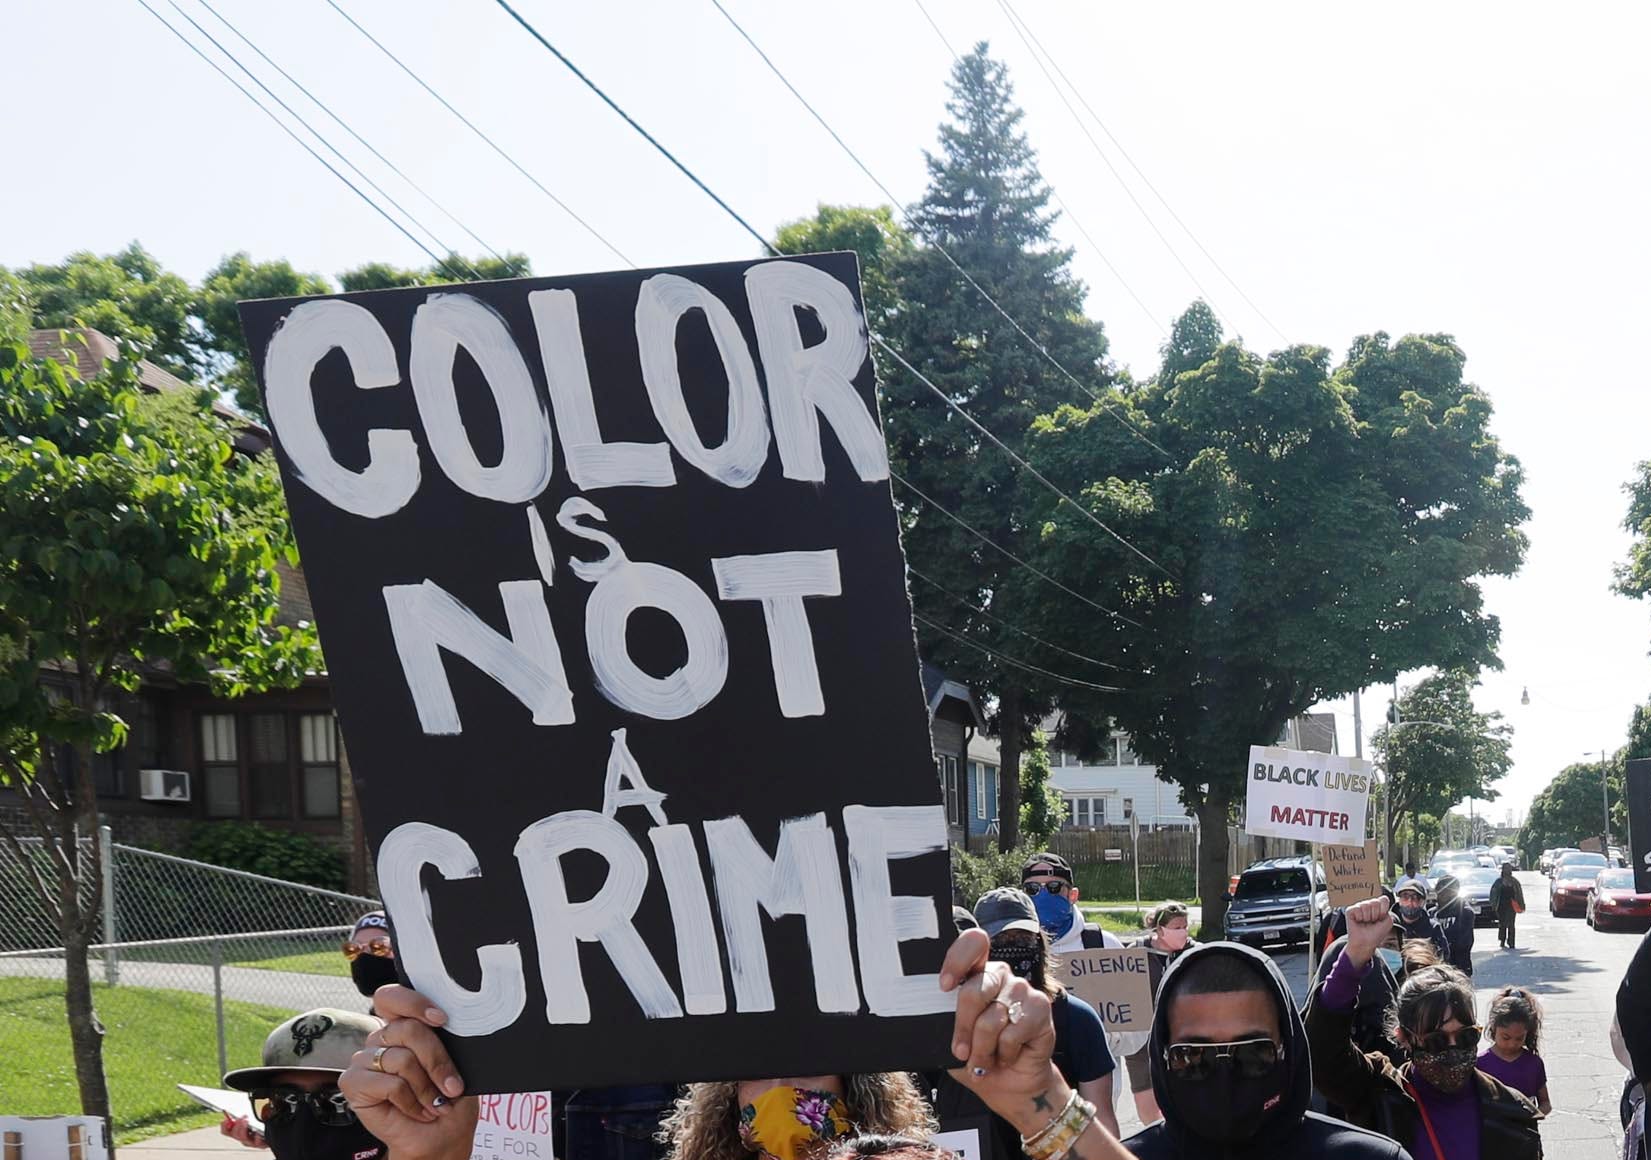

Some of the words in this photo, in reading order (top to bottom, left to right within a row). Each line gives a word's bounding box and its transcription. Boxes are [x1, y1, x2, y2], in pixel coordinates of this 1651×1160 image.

[263, 260, 889, 518] COLOR
[527, 497, 623, 587] IS
[383, 550, 843, 735] NOT
[602, 728, 669, 827] A
[1253, 763, 1320, 787] BLACK
[1324, 771, 1367, 793] LIVES
[1270, 805, 1349, 831] MATTER
[1328, 847, 1366, 861] Defund
[1332, 862, 1363, 877] White
[1329, 881, 1374, 896] Supremacy
[376, 804, 957, 1038] CRIME
[1070, 955, 1147, 977] SILENCE
[503, 1137, 540, 1158] FOR
